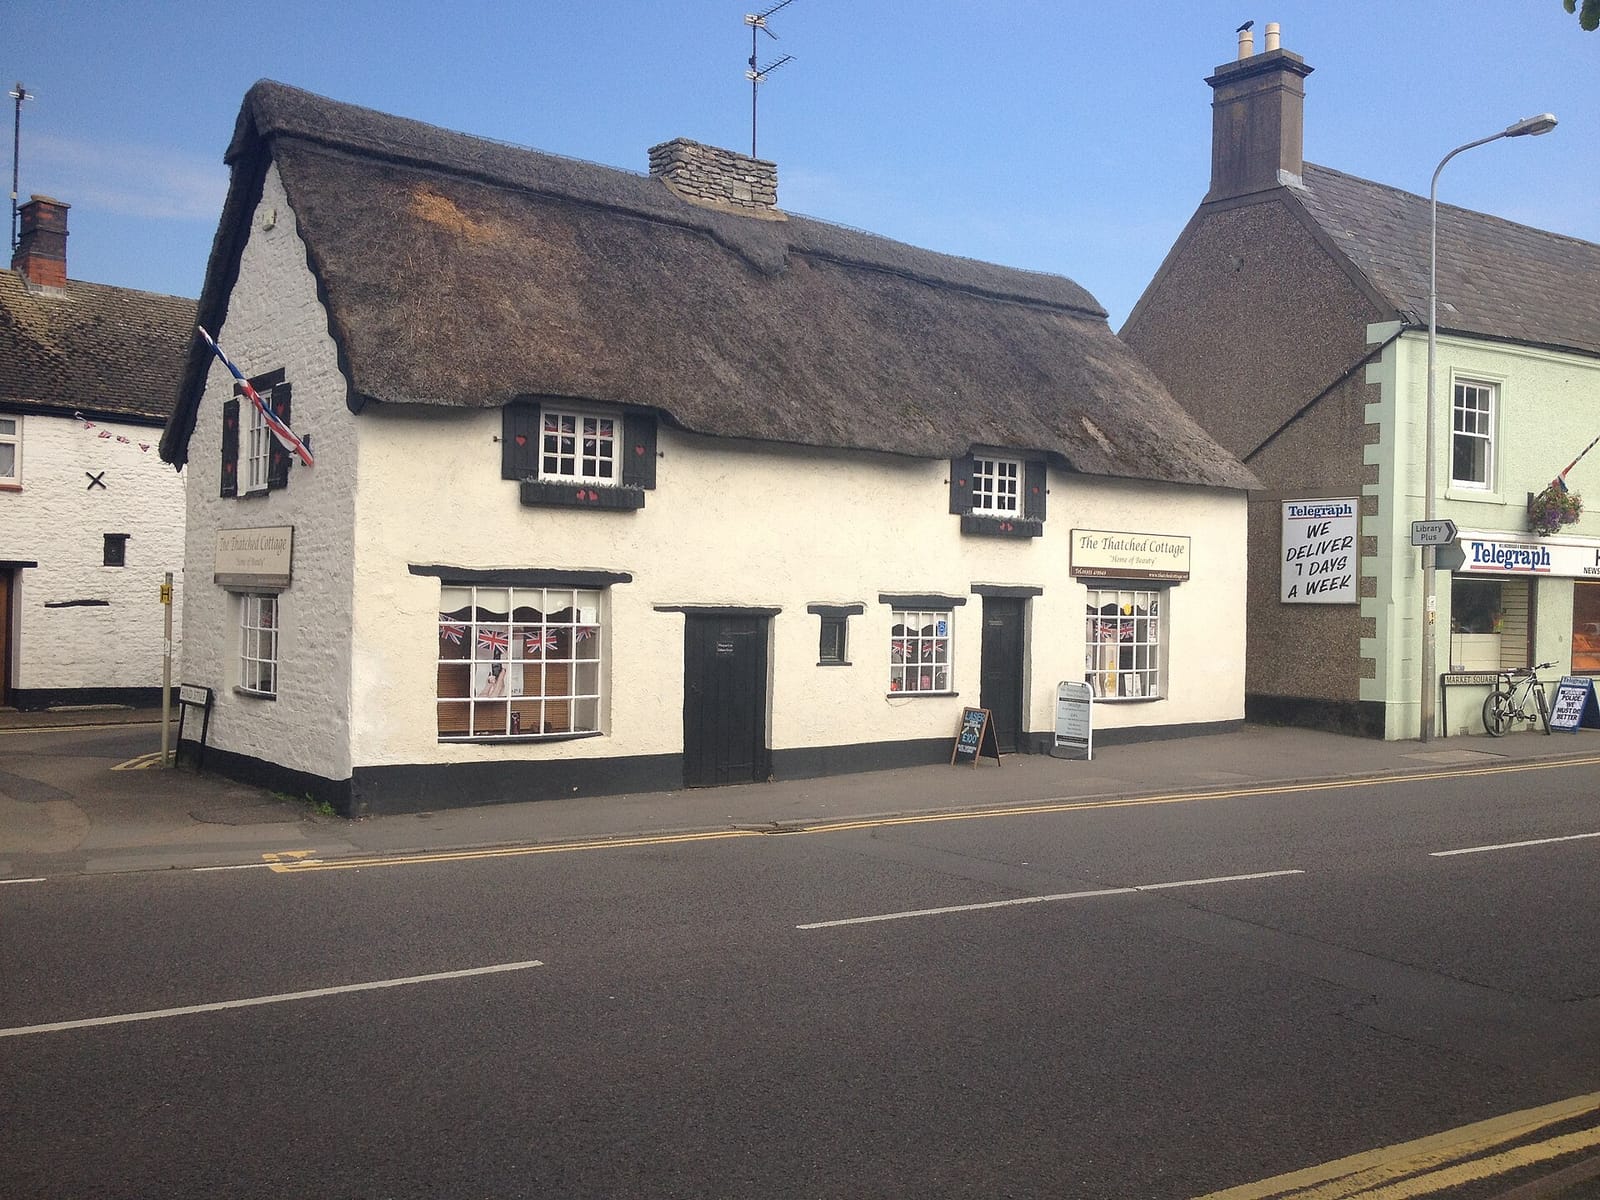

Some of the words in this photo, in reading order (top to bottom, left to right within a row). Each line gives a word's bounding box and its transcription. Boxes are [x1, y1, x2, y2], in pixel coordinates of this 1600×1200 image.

[1288, 504, 1352, 518] Telegraph
[1307, 521, 1332, 538] WE
[260, 536, 287, 556] Cottage
[1080, 535, 1098, 549] The
[1101, 536, 1148, 552] Thatched
[1149, 539, 1184, 558] Cottage
[1286, 536, 1353, 562] DELIVER
[1472, 542, 1550, 570] Telegraph
[1296, 564, 1302, 576] 7
[1309, 556, 1348, 576] DAYS
[162, 586, 170, 601] H
[1288, 584, 1298, 598] A
[1306, 574, 1352, 596] WEEK
[964, 710, 986, 722] LASER
